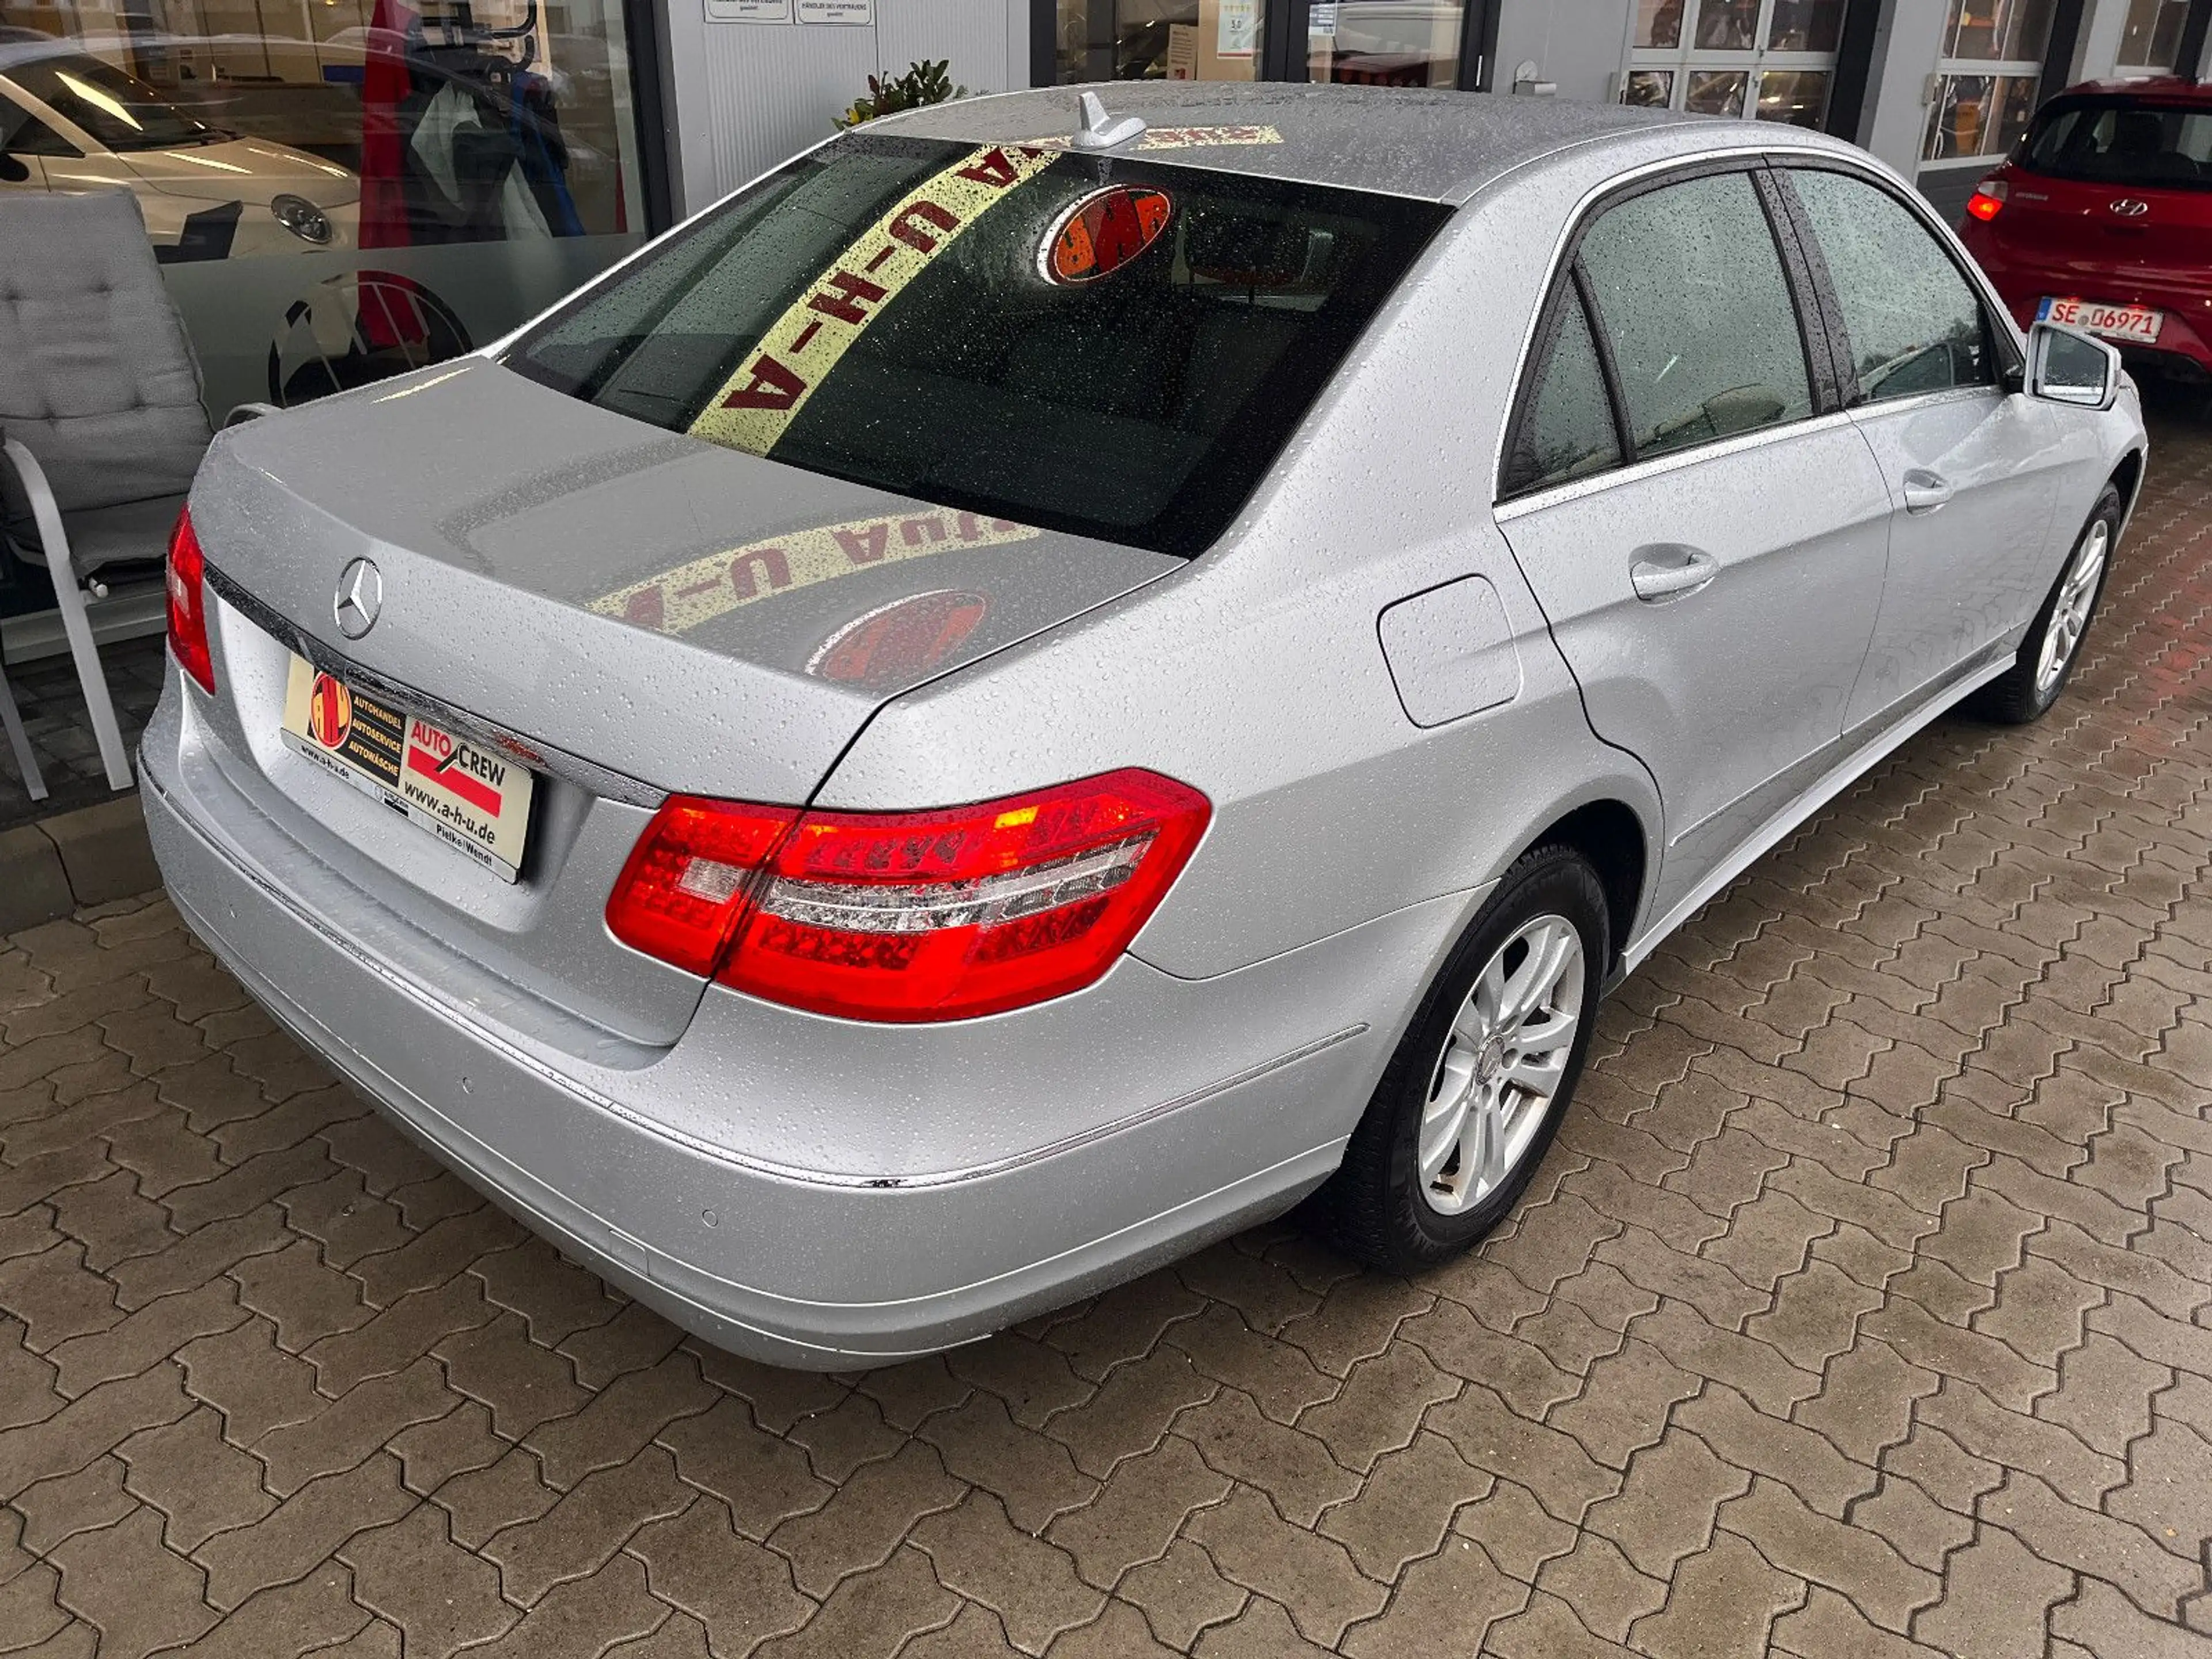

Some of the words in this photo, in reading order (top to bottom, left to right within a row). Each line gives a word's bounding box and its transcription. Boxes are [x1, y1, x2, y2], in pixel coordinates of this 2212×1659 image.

[2052, 303, 2080, 324] SE
[2090, 308, 2153, 335] 06971
[353, 696, 402, 729] AUTOHANDEL
[352, 719, 402, 753] AUTOSERVICE
[411, 720, 452, 757] AUTO
[459, 745, 506, 786] CREW
[404, 781, 496, 844] www.a-h-u.de
